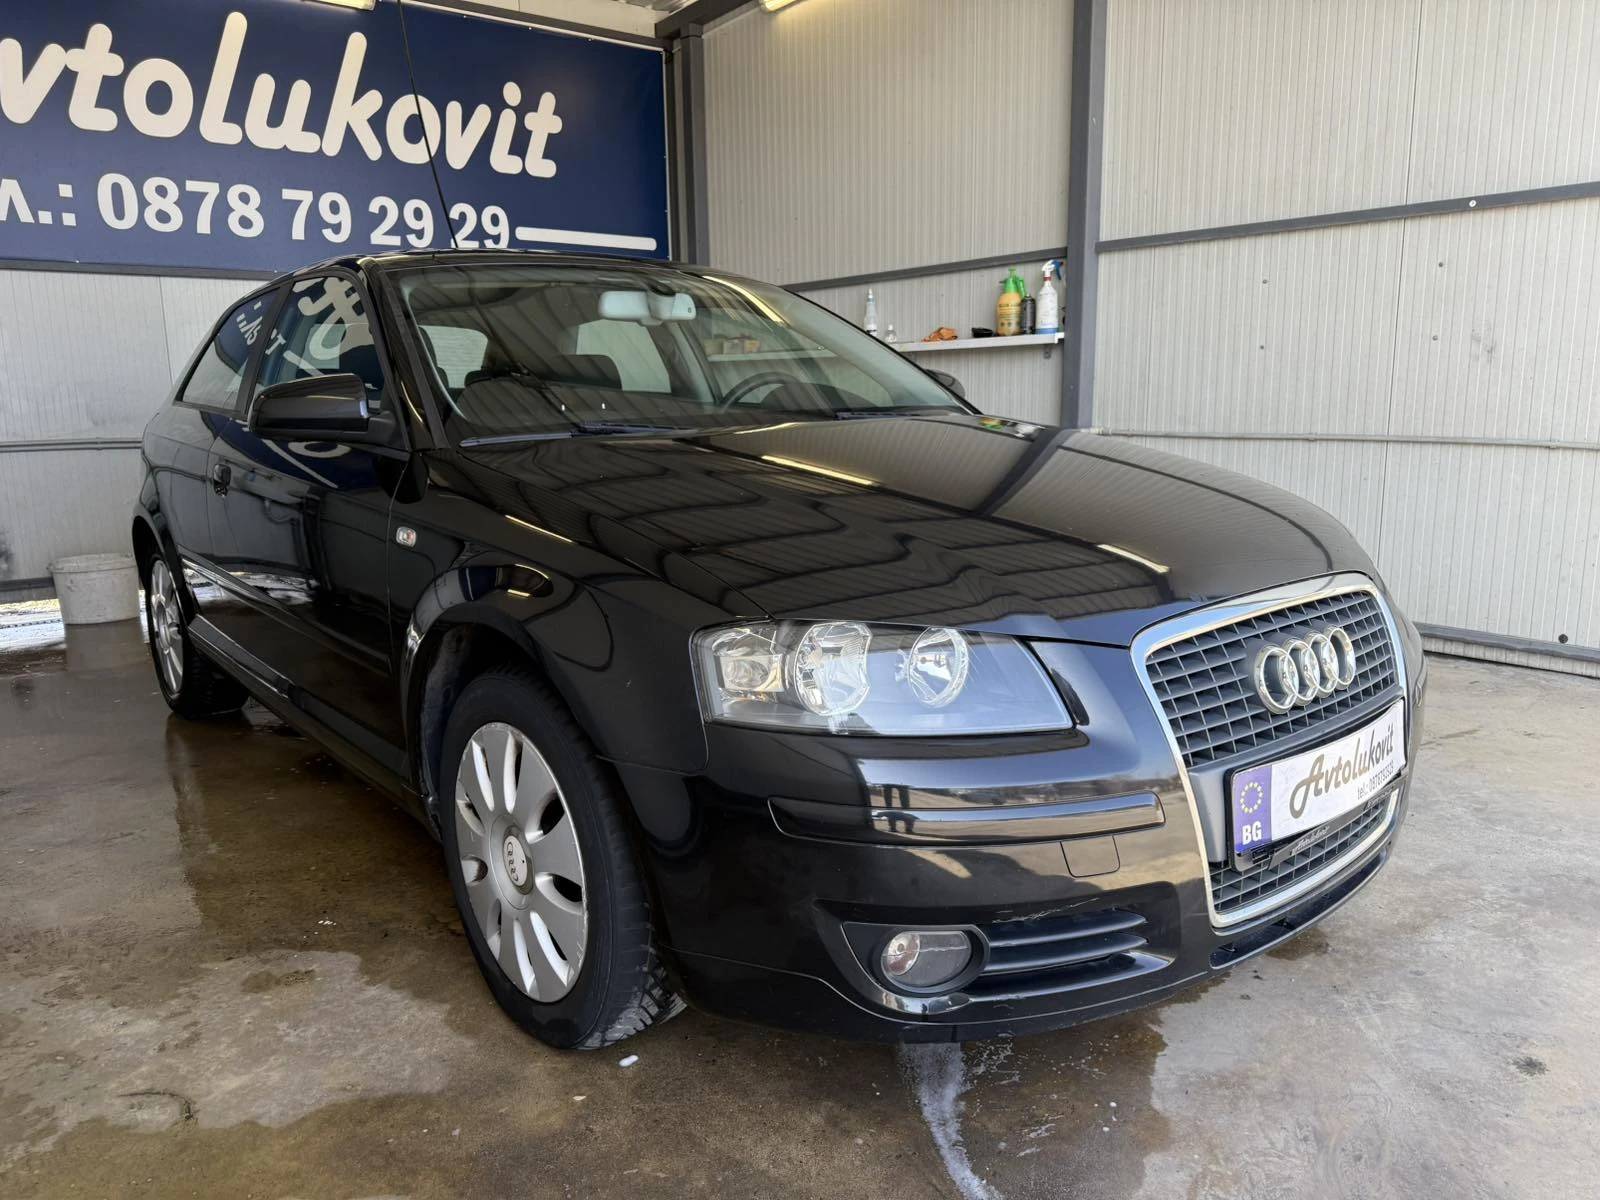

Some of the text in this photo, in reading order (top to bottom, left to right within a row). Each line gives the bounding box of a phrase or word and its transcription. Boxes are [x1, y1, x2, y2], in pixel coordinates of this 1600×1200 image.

[97, 172, 265, 238] 0878
[281, 188, 353, 243] 79
[368, 195, 434, 248] 29
[450, 202, 511, 249] 29
[1289, 722, 1394, 819] Avtolukovit
[1242, 821, 1262, 845] BG
